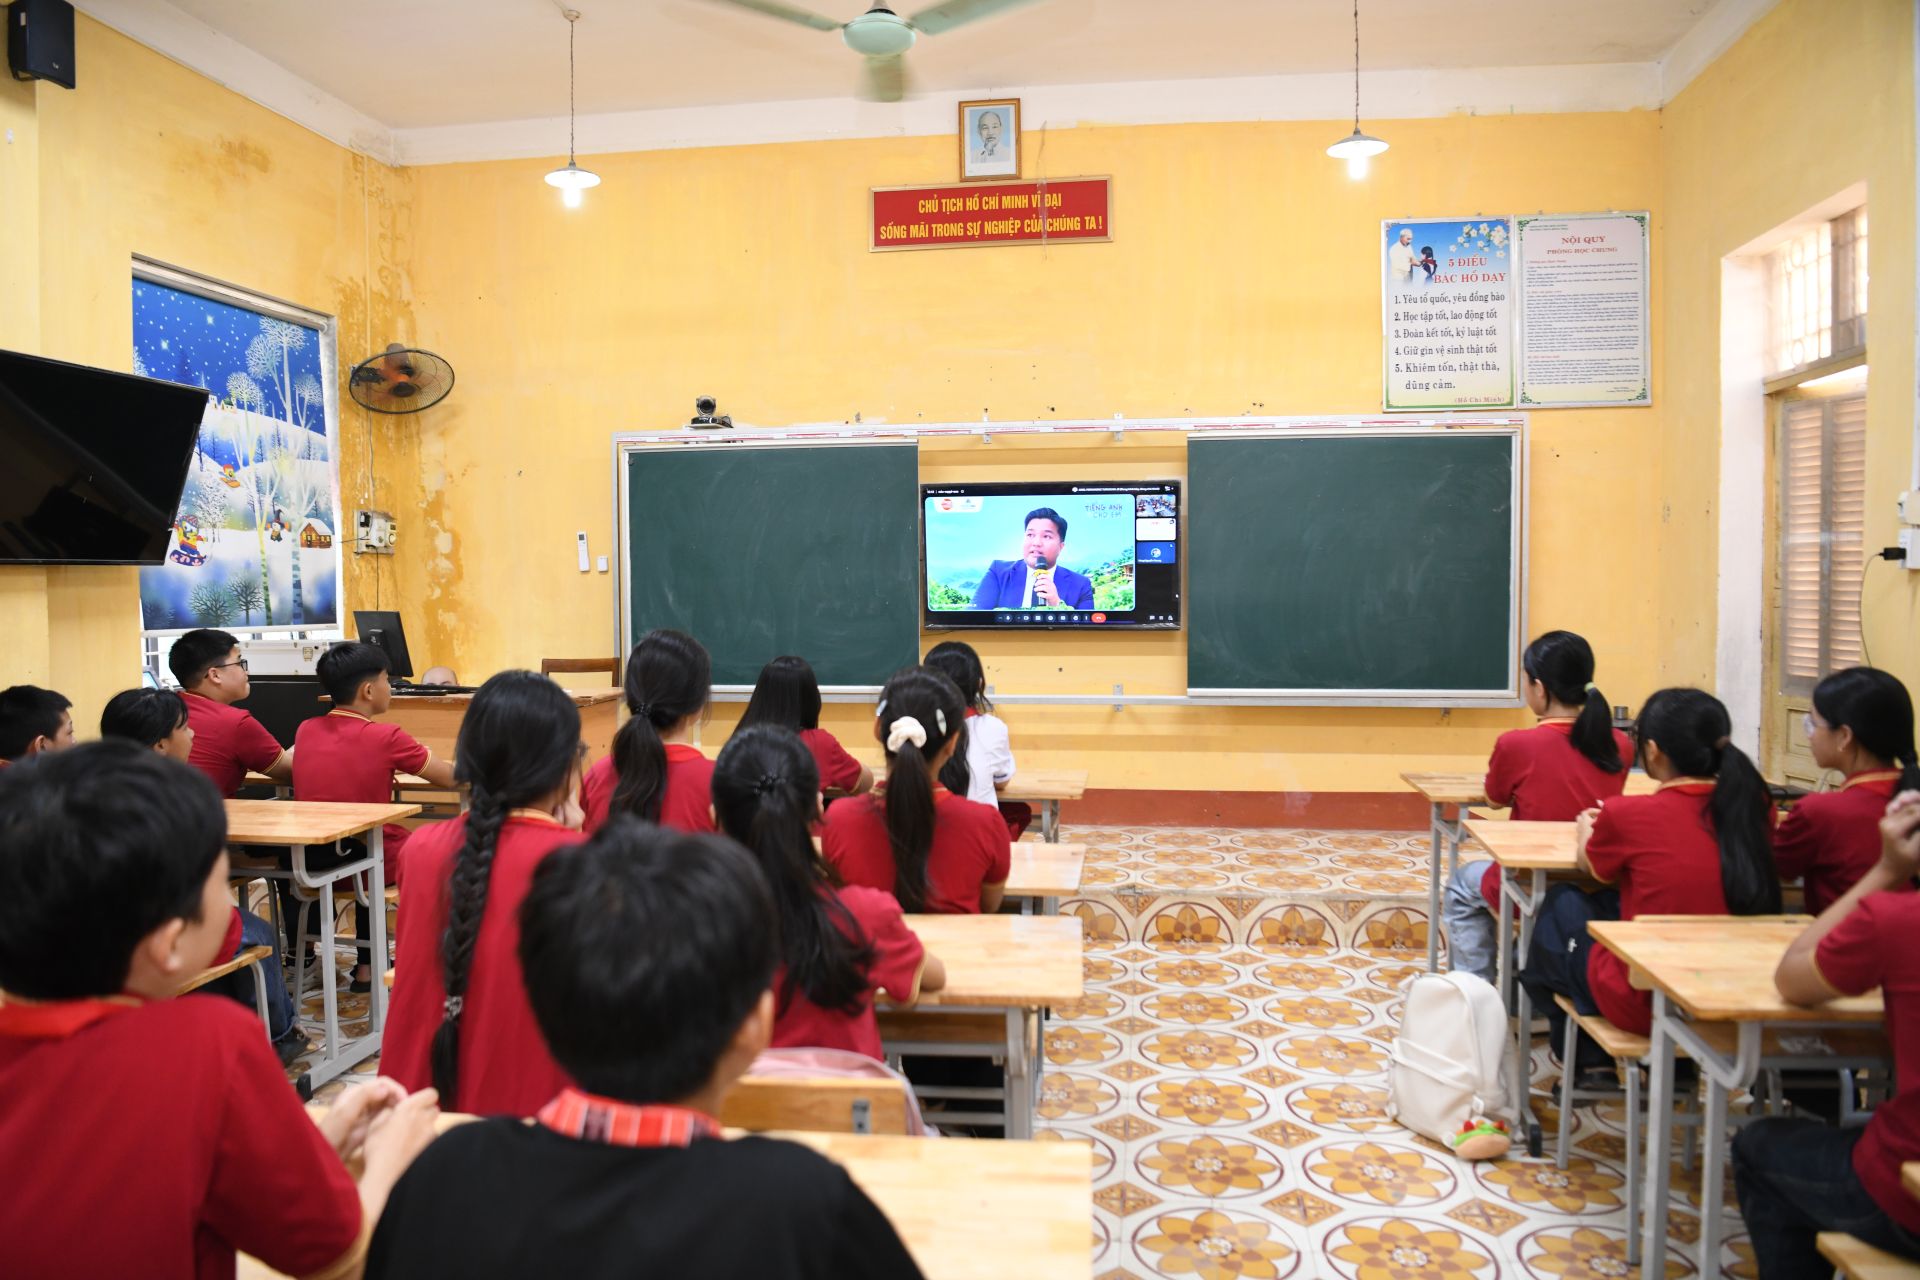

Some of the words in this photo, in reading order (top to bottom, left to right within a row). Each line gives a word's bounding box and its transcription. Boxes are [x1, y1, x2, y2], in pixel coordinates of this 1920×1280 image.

[918, 194, 938, 214] CHỦ
[941, 197, 963, 214] TỊCH
[966, 193, 980, 211] HỒ
[982, 194, 998, 210] CHÍ
[1002, 194, 1028, 208] MINH
[1032, 191, 1041, 207] VĨ
[1044, 193, 1062, 209] ĐẠI
[880, 221, 906, 240] SỐNG
[910, 222, 928, 238] MÃI
[932, 223, 964, 238] TRONG
[966, 220, 982, 238] SỰ
[984, 217, 1021, 236] NGHIỆP
[1024, 214, 1043, 232] CỦA
[1046, 214, 1080, 232] CHÚNG
[1084, 216, 1096, 230] TA
[1098, 216, 1103, 230] !
[1562, 235, 1580, 246] NỘI
[1584, 236, 1606, 244] QUY
[1448, 259, 1454, 267] 5
[1458, 254, 1487, 267] ĐIỀU
[1434, 271, 1457, 283] BÁC
[1461, 270, 1478, 282] HỒ
[1482, 273, 1506, 284] DẠY
[1394, 296, 1401, 304] 1.
[1403, 294, 1418, 304] Yêu
[1420, 292, 1427, 303] tổ
[1430, 292, 1451, 305] quốc,
[1453, 294, 1467, 304] yêu
[1469, 291, 1488, 303] đồng
[1491, 292, 1505, 301] bào
[1394, 312, 1400, 321] 2.
[1403, 312, 1418, 323] Học
[1420, 312, 1433, 322] tập
[1436, 310, 1448, 321] tốt,
[1451, 310, 1462, 319] lao
[1465, 310, 1484, 321] động
[1486, 308, 1497, 319] tốt
[1394, 330, 1401, 338] 3.
[1403, 328, 1424, 338] Đoàn
[1426, 326, 1438, 337] kết
[1441, 326, 1453, 337] tốt,
[1468, 327, 1483, 338] luật
[1485, 325, 1496, 336] tốt
[1395, 347, 1402, 356] 4.
[1404, 346, 1418, 355] Giữ
[1420, 347, 1433, 357] gìn
[1436, 347, 1444, 357] vệ
[1447, 345, 1464, 354] sinh
[1467, 344, 1483, 356] thật
[1485, 343, 1497, 353] tốt
[1395, 364, 1402, 373] 5.
[1406, 363, 1436, 373] Khiêm
[1438, 361, 1457, 372] tốn,
[1459, 362, 1478, 373] thật
[1481, 361, 1500, 372] thà,
[1406, 380, 1430, 391] dũng
[1433, 379, 1456, 389] cảm.
